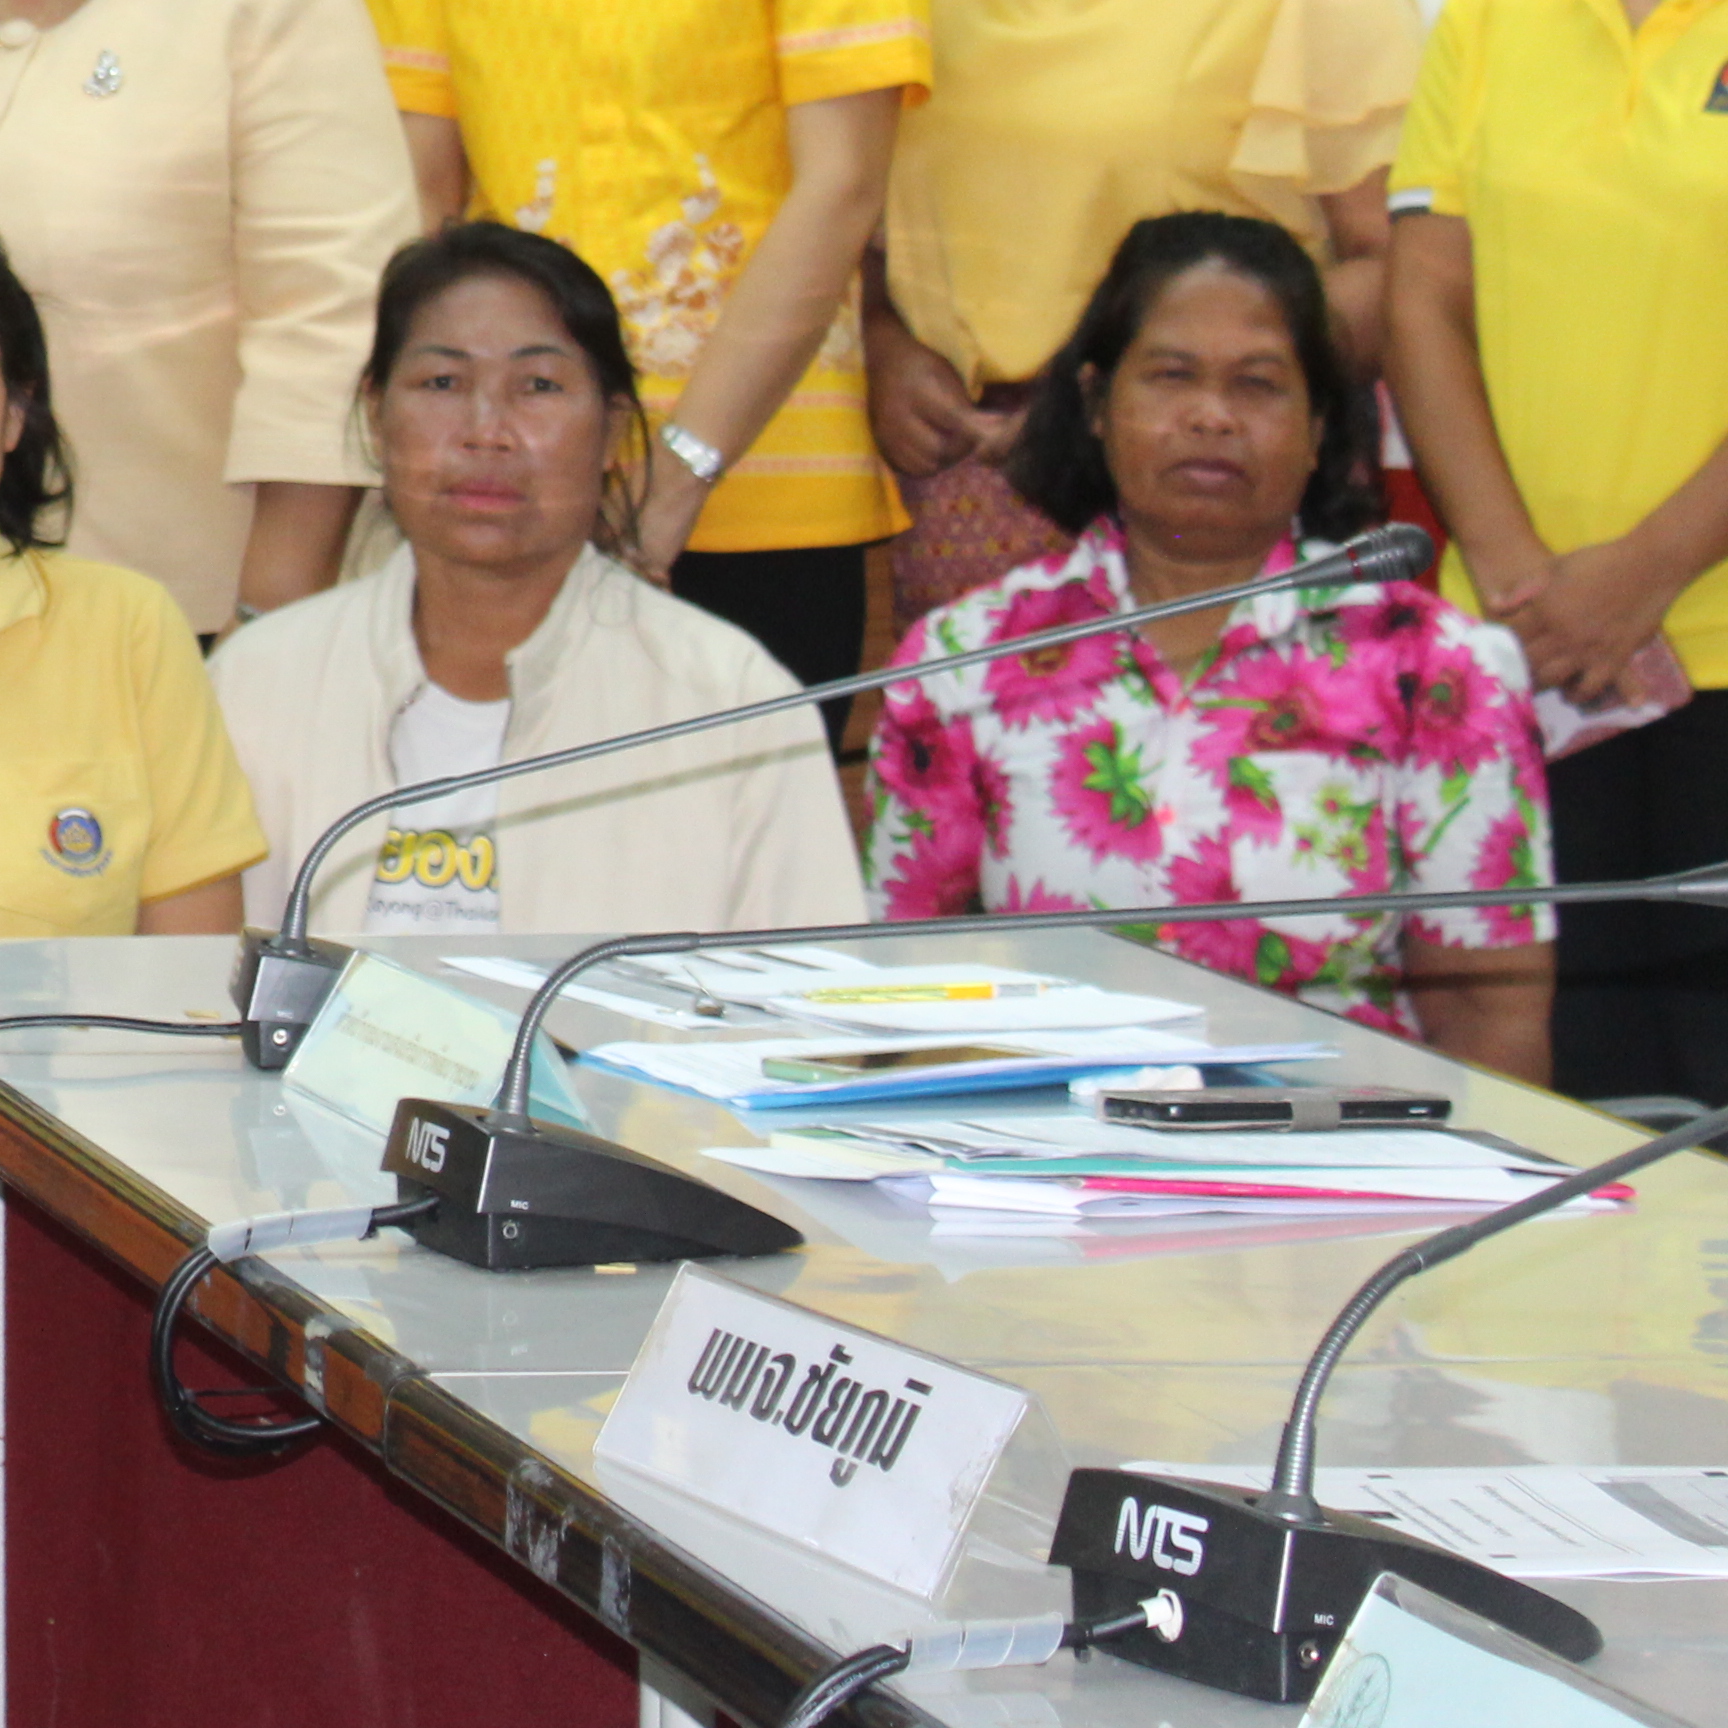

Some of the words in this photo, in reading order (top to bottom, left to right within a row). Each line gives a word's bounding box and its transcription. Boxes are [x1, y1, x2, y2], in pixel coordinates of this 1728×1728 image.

[405, 1117, 451, 1173] NTS
[510, 1199, 530, 1211] MIC
[1114, 1496, 1209, 1576] NTS
[1313, 1613, 1334, 1627] MIC
